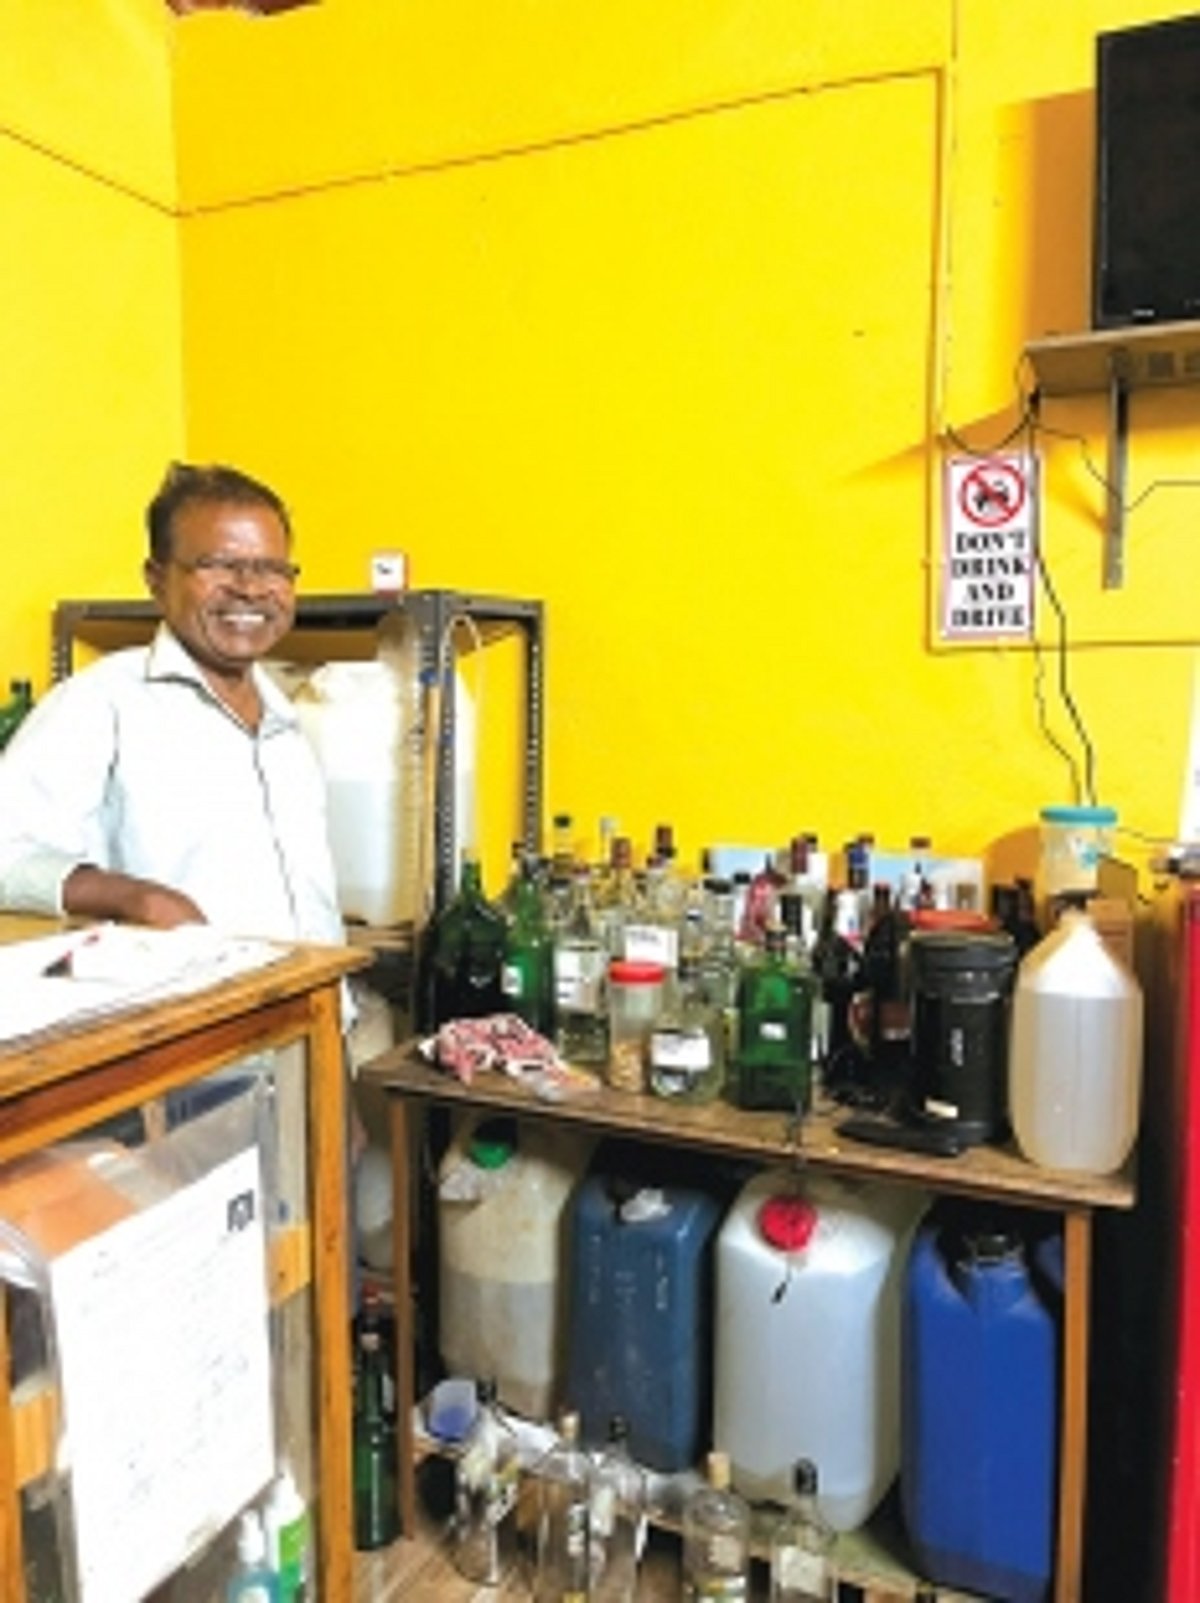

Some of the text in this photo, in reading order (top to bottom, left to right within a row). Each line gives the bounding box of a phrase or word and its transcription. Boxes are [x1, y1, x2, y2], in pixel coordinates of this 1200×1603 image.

[956, 531, 1025, 553] DON'T
[952, 557, 1028, 578] DRINK
[966, 583, 1014, 602] AND
[952, 607, 1025, 627] DRIVE
